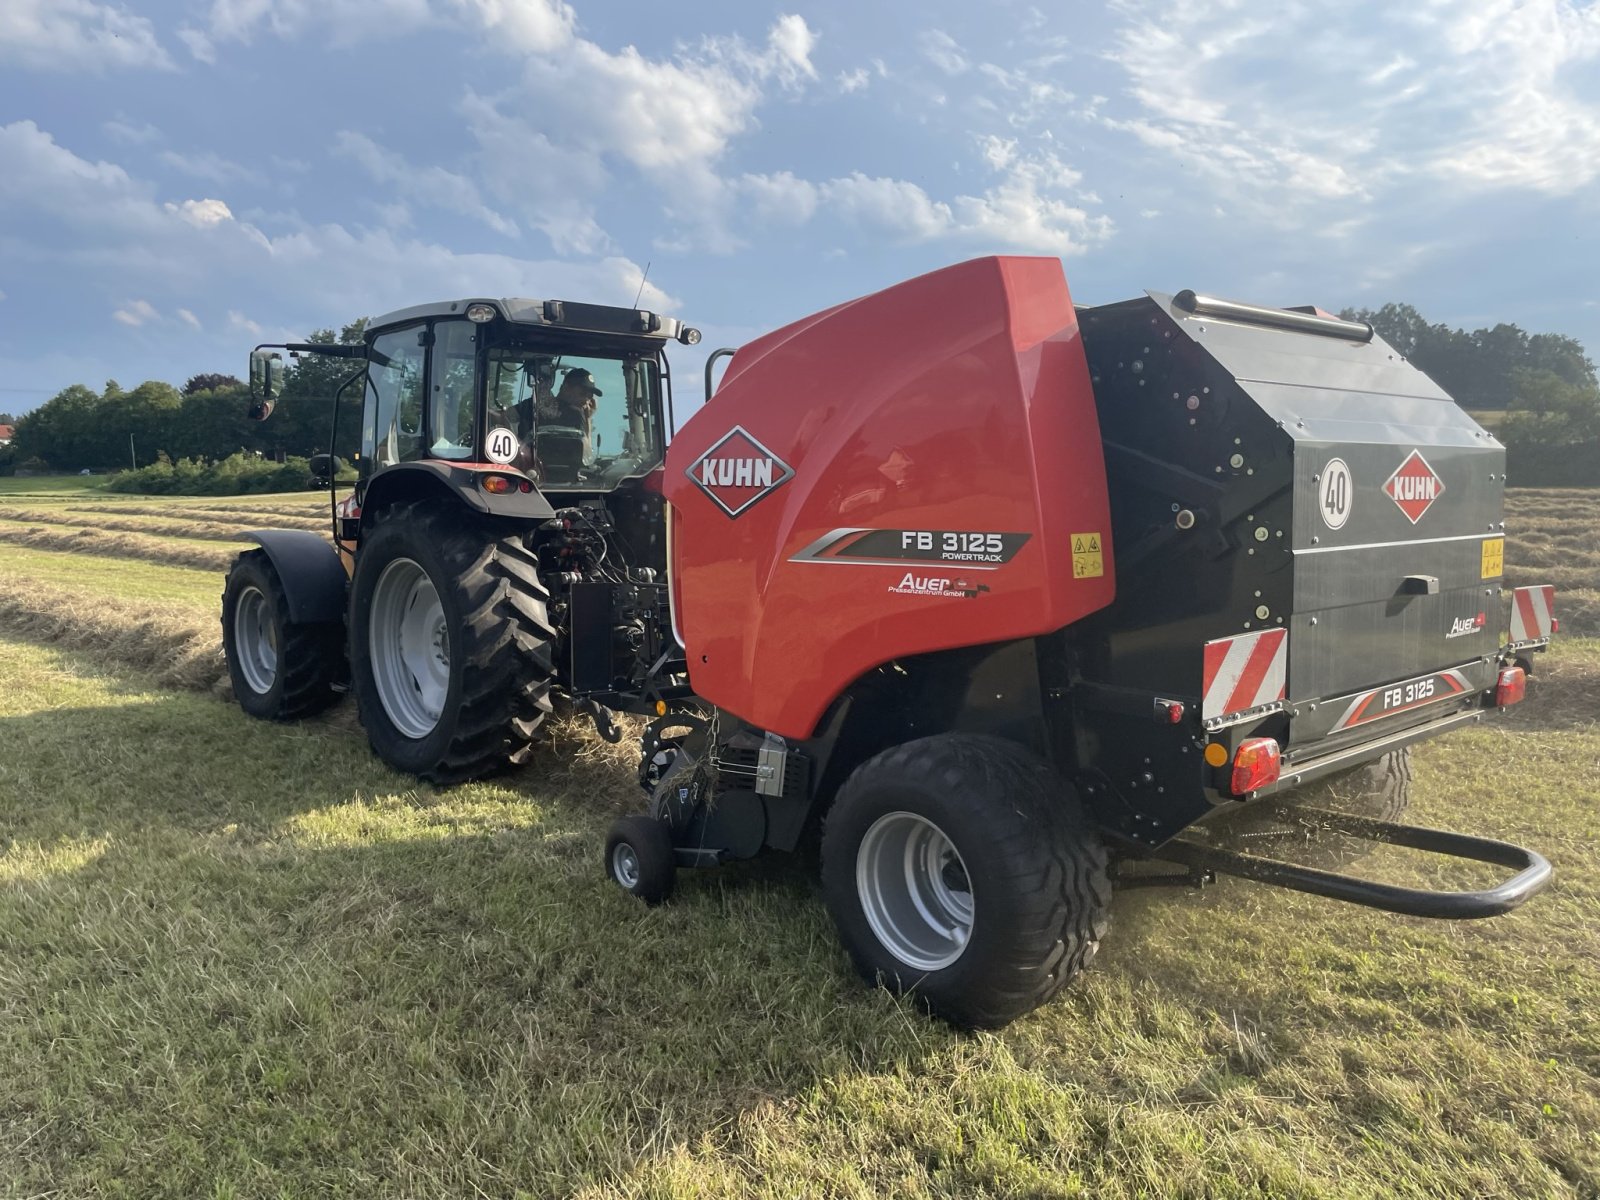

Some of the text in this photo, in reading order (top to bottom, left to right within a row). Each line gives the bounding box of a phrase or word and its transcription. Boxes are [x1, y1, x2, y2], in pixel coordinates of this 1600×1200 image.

[492, 435, 511, 457] 40
[702, 458, 773, 487] KUHN
[1325, 470, 1346, 515] 40
[1393, 476, 1436, 501] KUHN
[901, 531, 1003, 553] FB 3125
[942, 552, 1002, 562] POWERTRACK
[943, 590, 966, 598] GmbH
[1383, 678, 1435, 709] FB 3125
